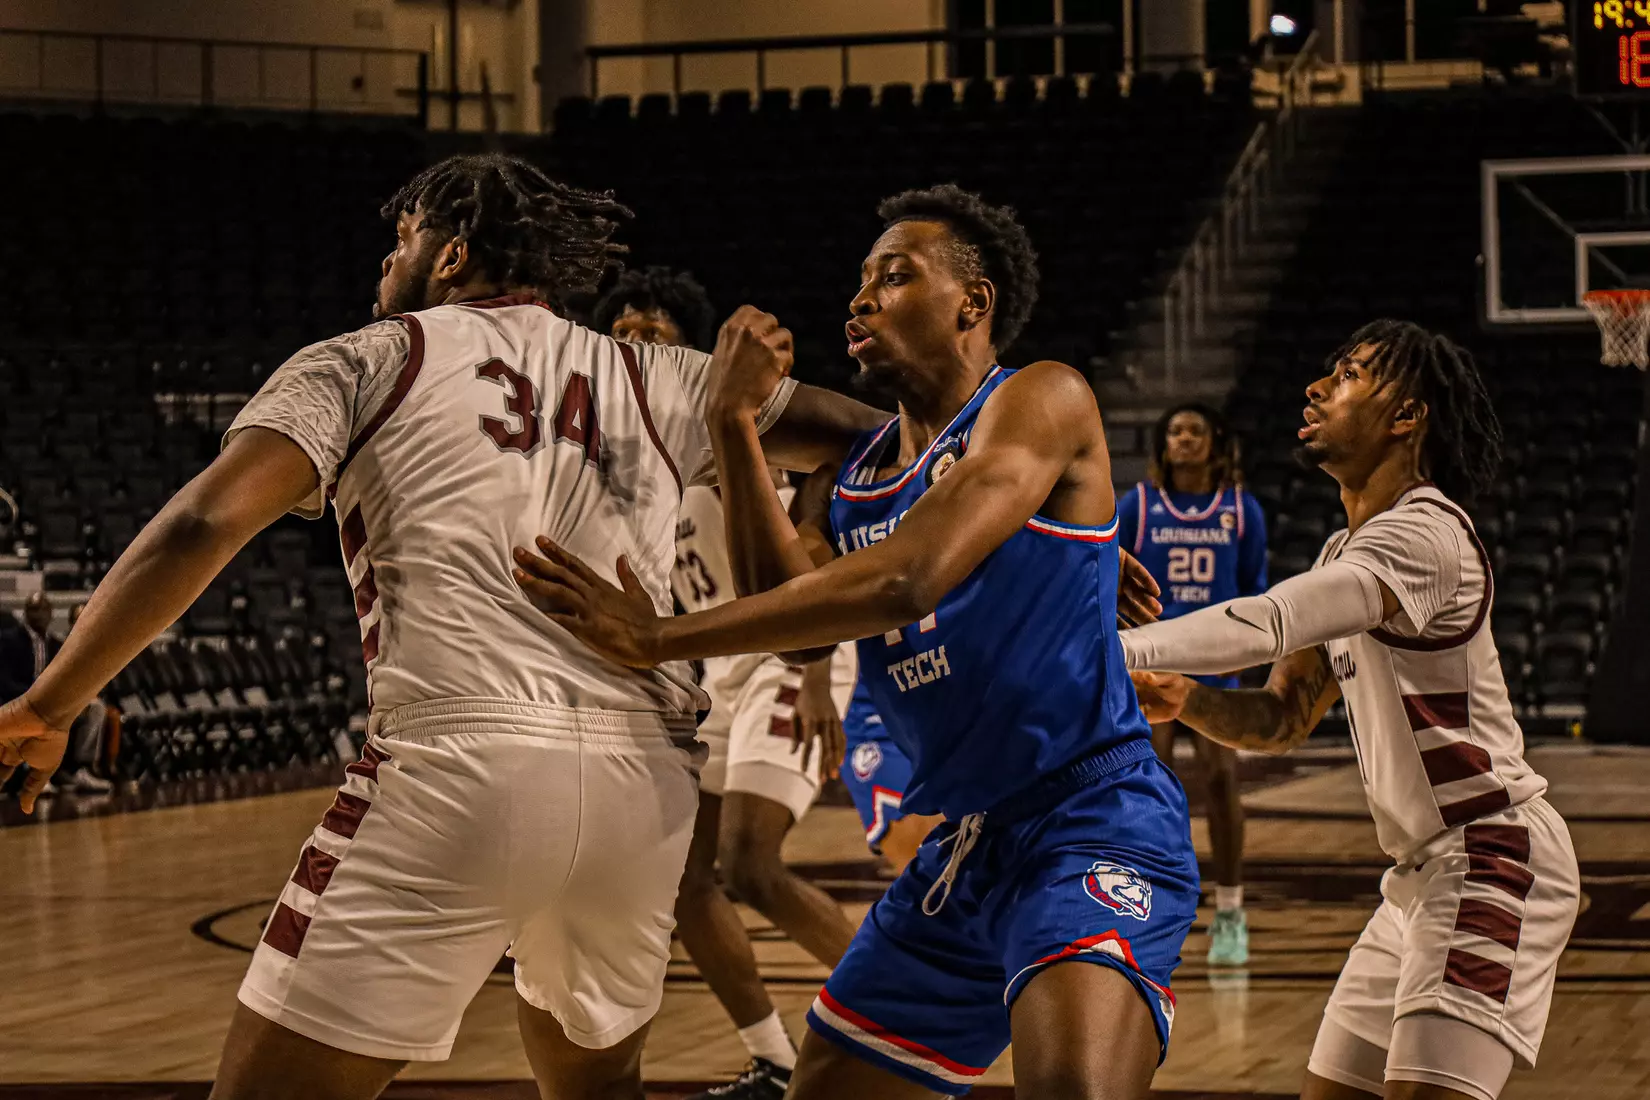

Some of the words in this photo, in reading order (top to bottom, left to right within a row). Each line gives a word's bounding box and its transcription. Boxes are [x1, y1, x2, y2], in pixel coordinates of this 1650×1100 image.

[474, 356, 610, 471] 34
[1151, 527, 1231, 545] LOUISIANA
[1167, 547, 1215, 582] 20
[1170, 585, 1211, 603] TECH
[887, 645, 951, 692] TECH
